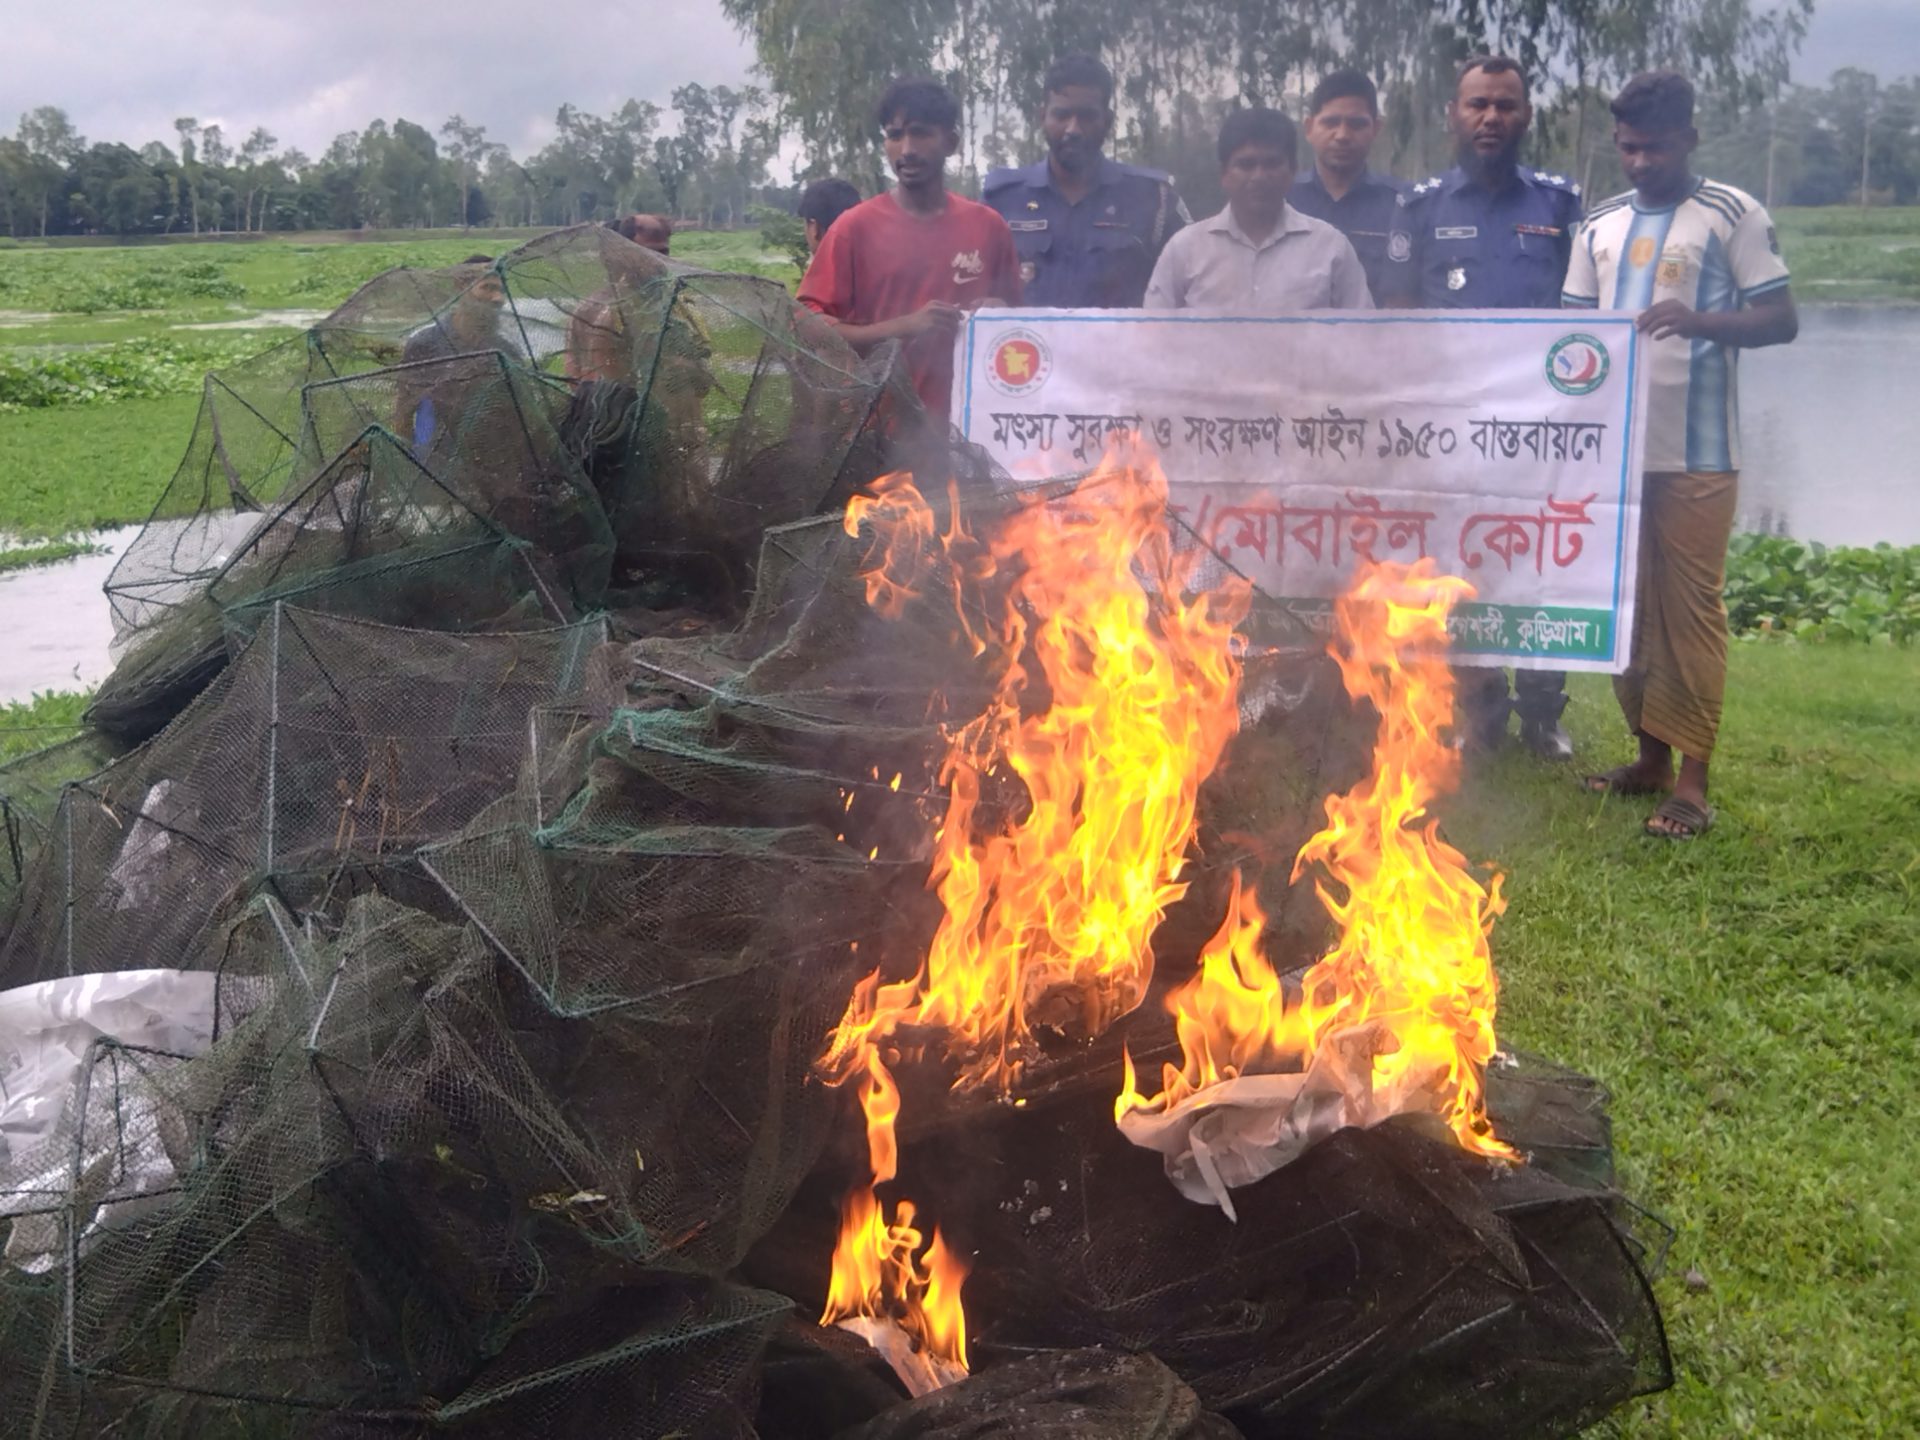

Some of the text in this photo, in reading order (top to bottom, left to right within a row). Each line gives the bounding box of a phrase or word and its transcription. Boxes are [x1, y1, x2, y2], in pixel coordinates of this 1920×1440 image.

[990, 413, 1059, 451] মৎস্য
[1152, 417, 1172, 449] ও
[1183, 412, 1284, 457] সংরক্ষণ
[1292, 404, 1368, 461] আইন
[1377, 418, 1457, 459] ১৯৫০
[1469, 415, 1607, 463] বাস্তবায়নে
[1459, 492, 1598, 576] কোর্ট
